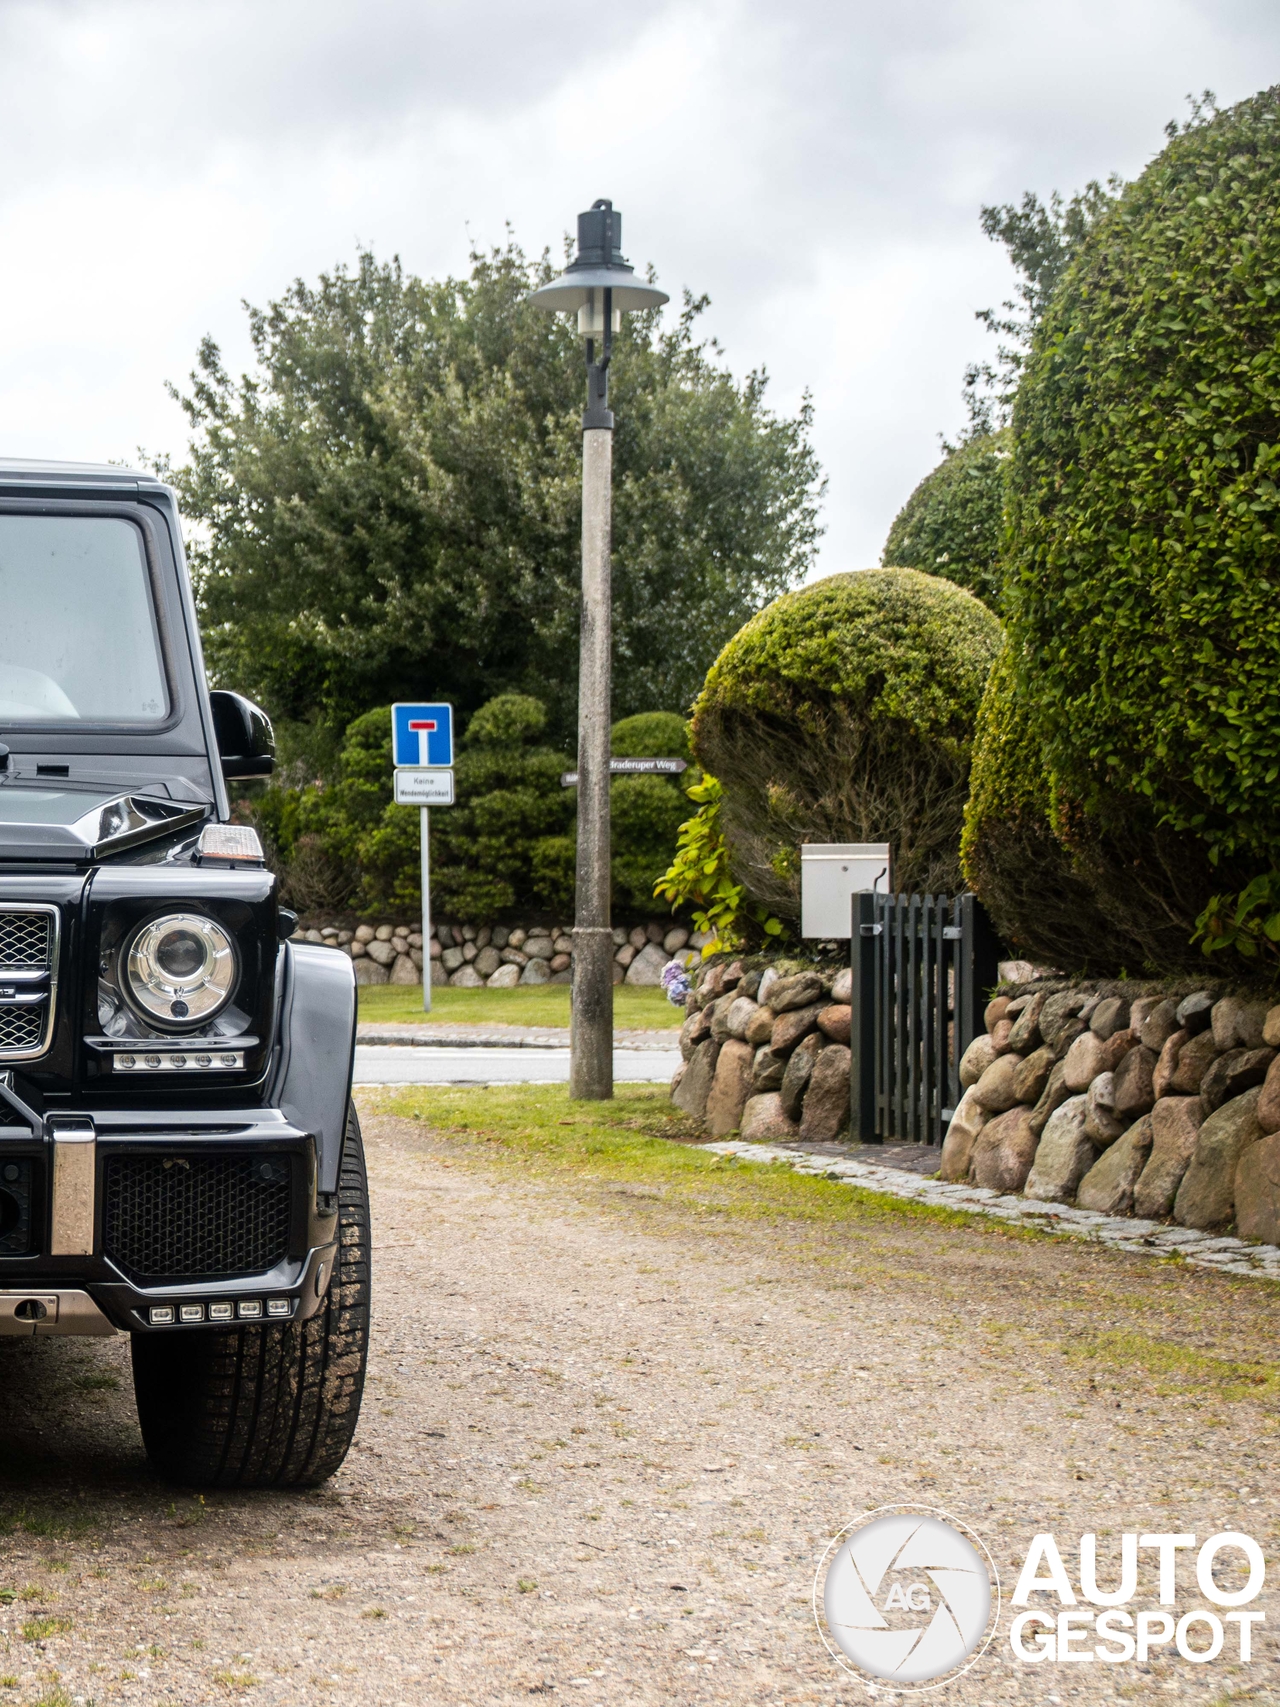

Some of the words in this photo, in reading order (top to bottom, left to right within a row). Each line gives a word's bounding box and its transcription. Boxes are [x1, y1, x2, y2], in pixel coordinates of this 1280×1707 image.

[656, 760, 677, 772] Weg
[413, 777, 435, 785] Keine
[399, 789, 449, 798] Wendemöglichkeit
